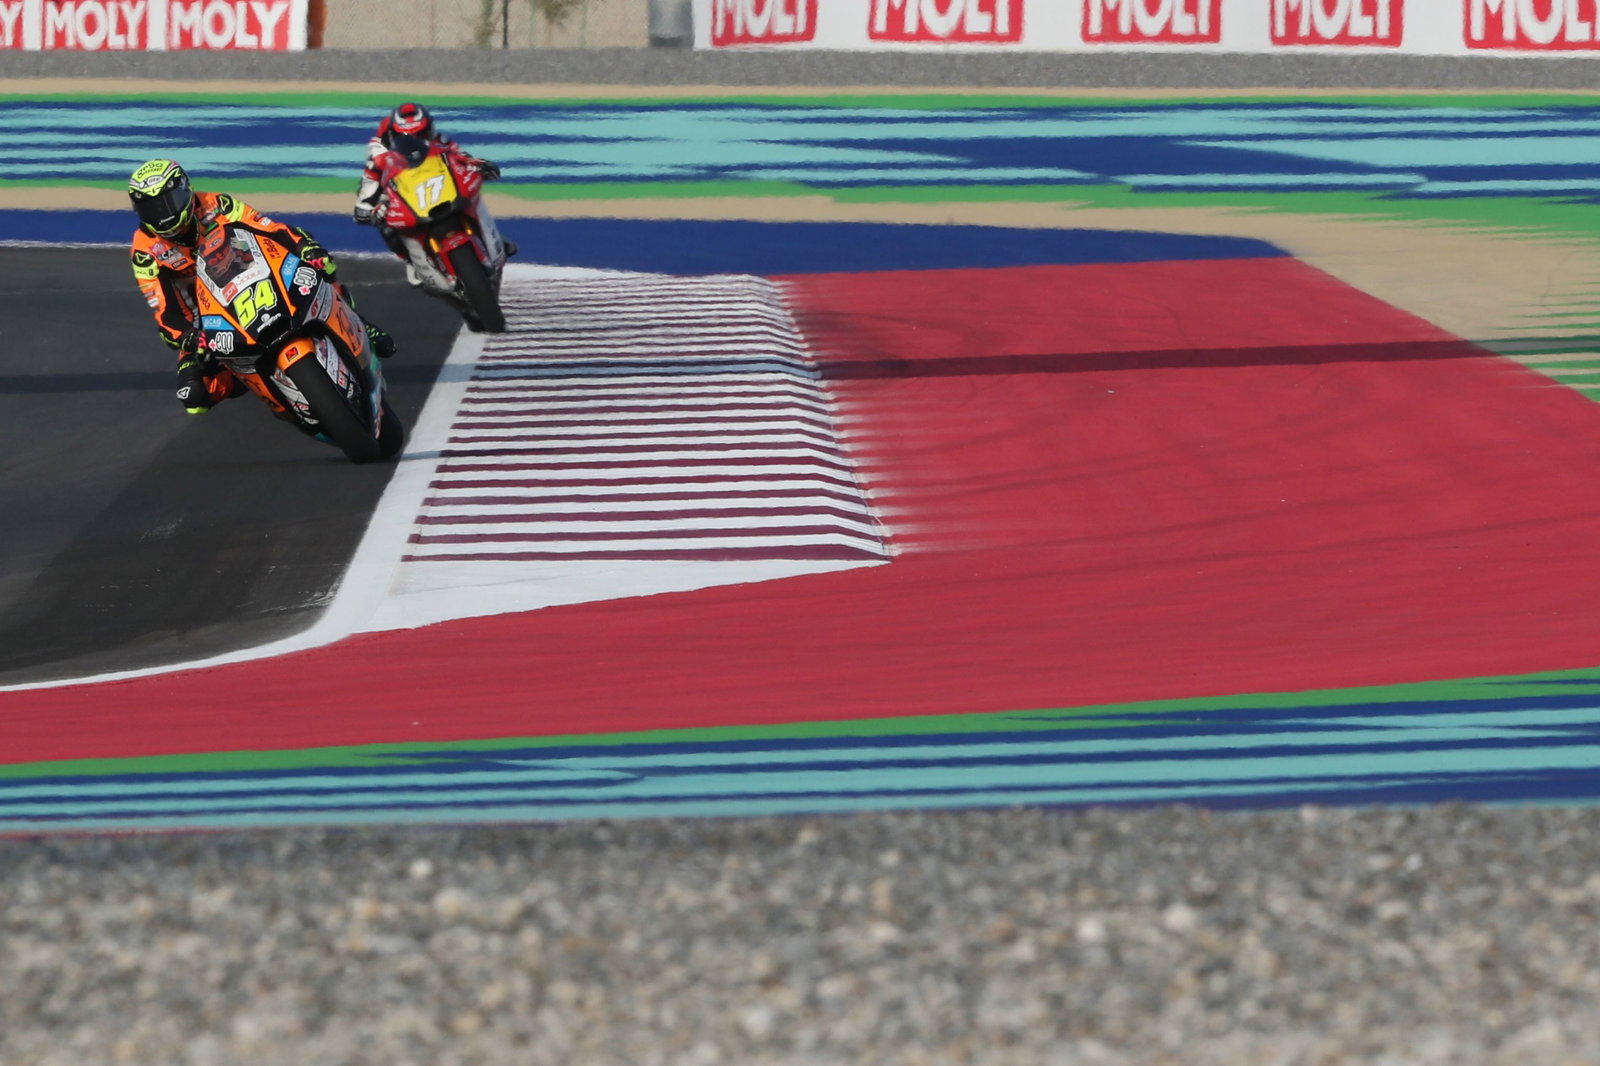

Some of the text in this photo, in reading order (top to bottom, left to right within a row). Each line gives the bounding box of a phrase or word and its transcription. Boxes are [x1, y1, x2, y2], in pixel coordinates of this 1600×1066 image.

[47, 0, 146, 49] MOLY
[172, 0, 289, 49] MOLY
[1470, 0, 1600, 44] MOL
[415, 174, 446, 210] 17
[233, 279, 277, 330] 54
